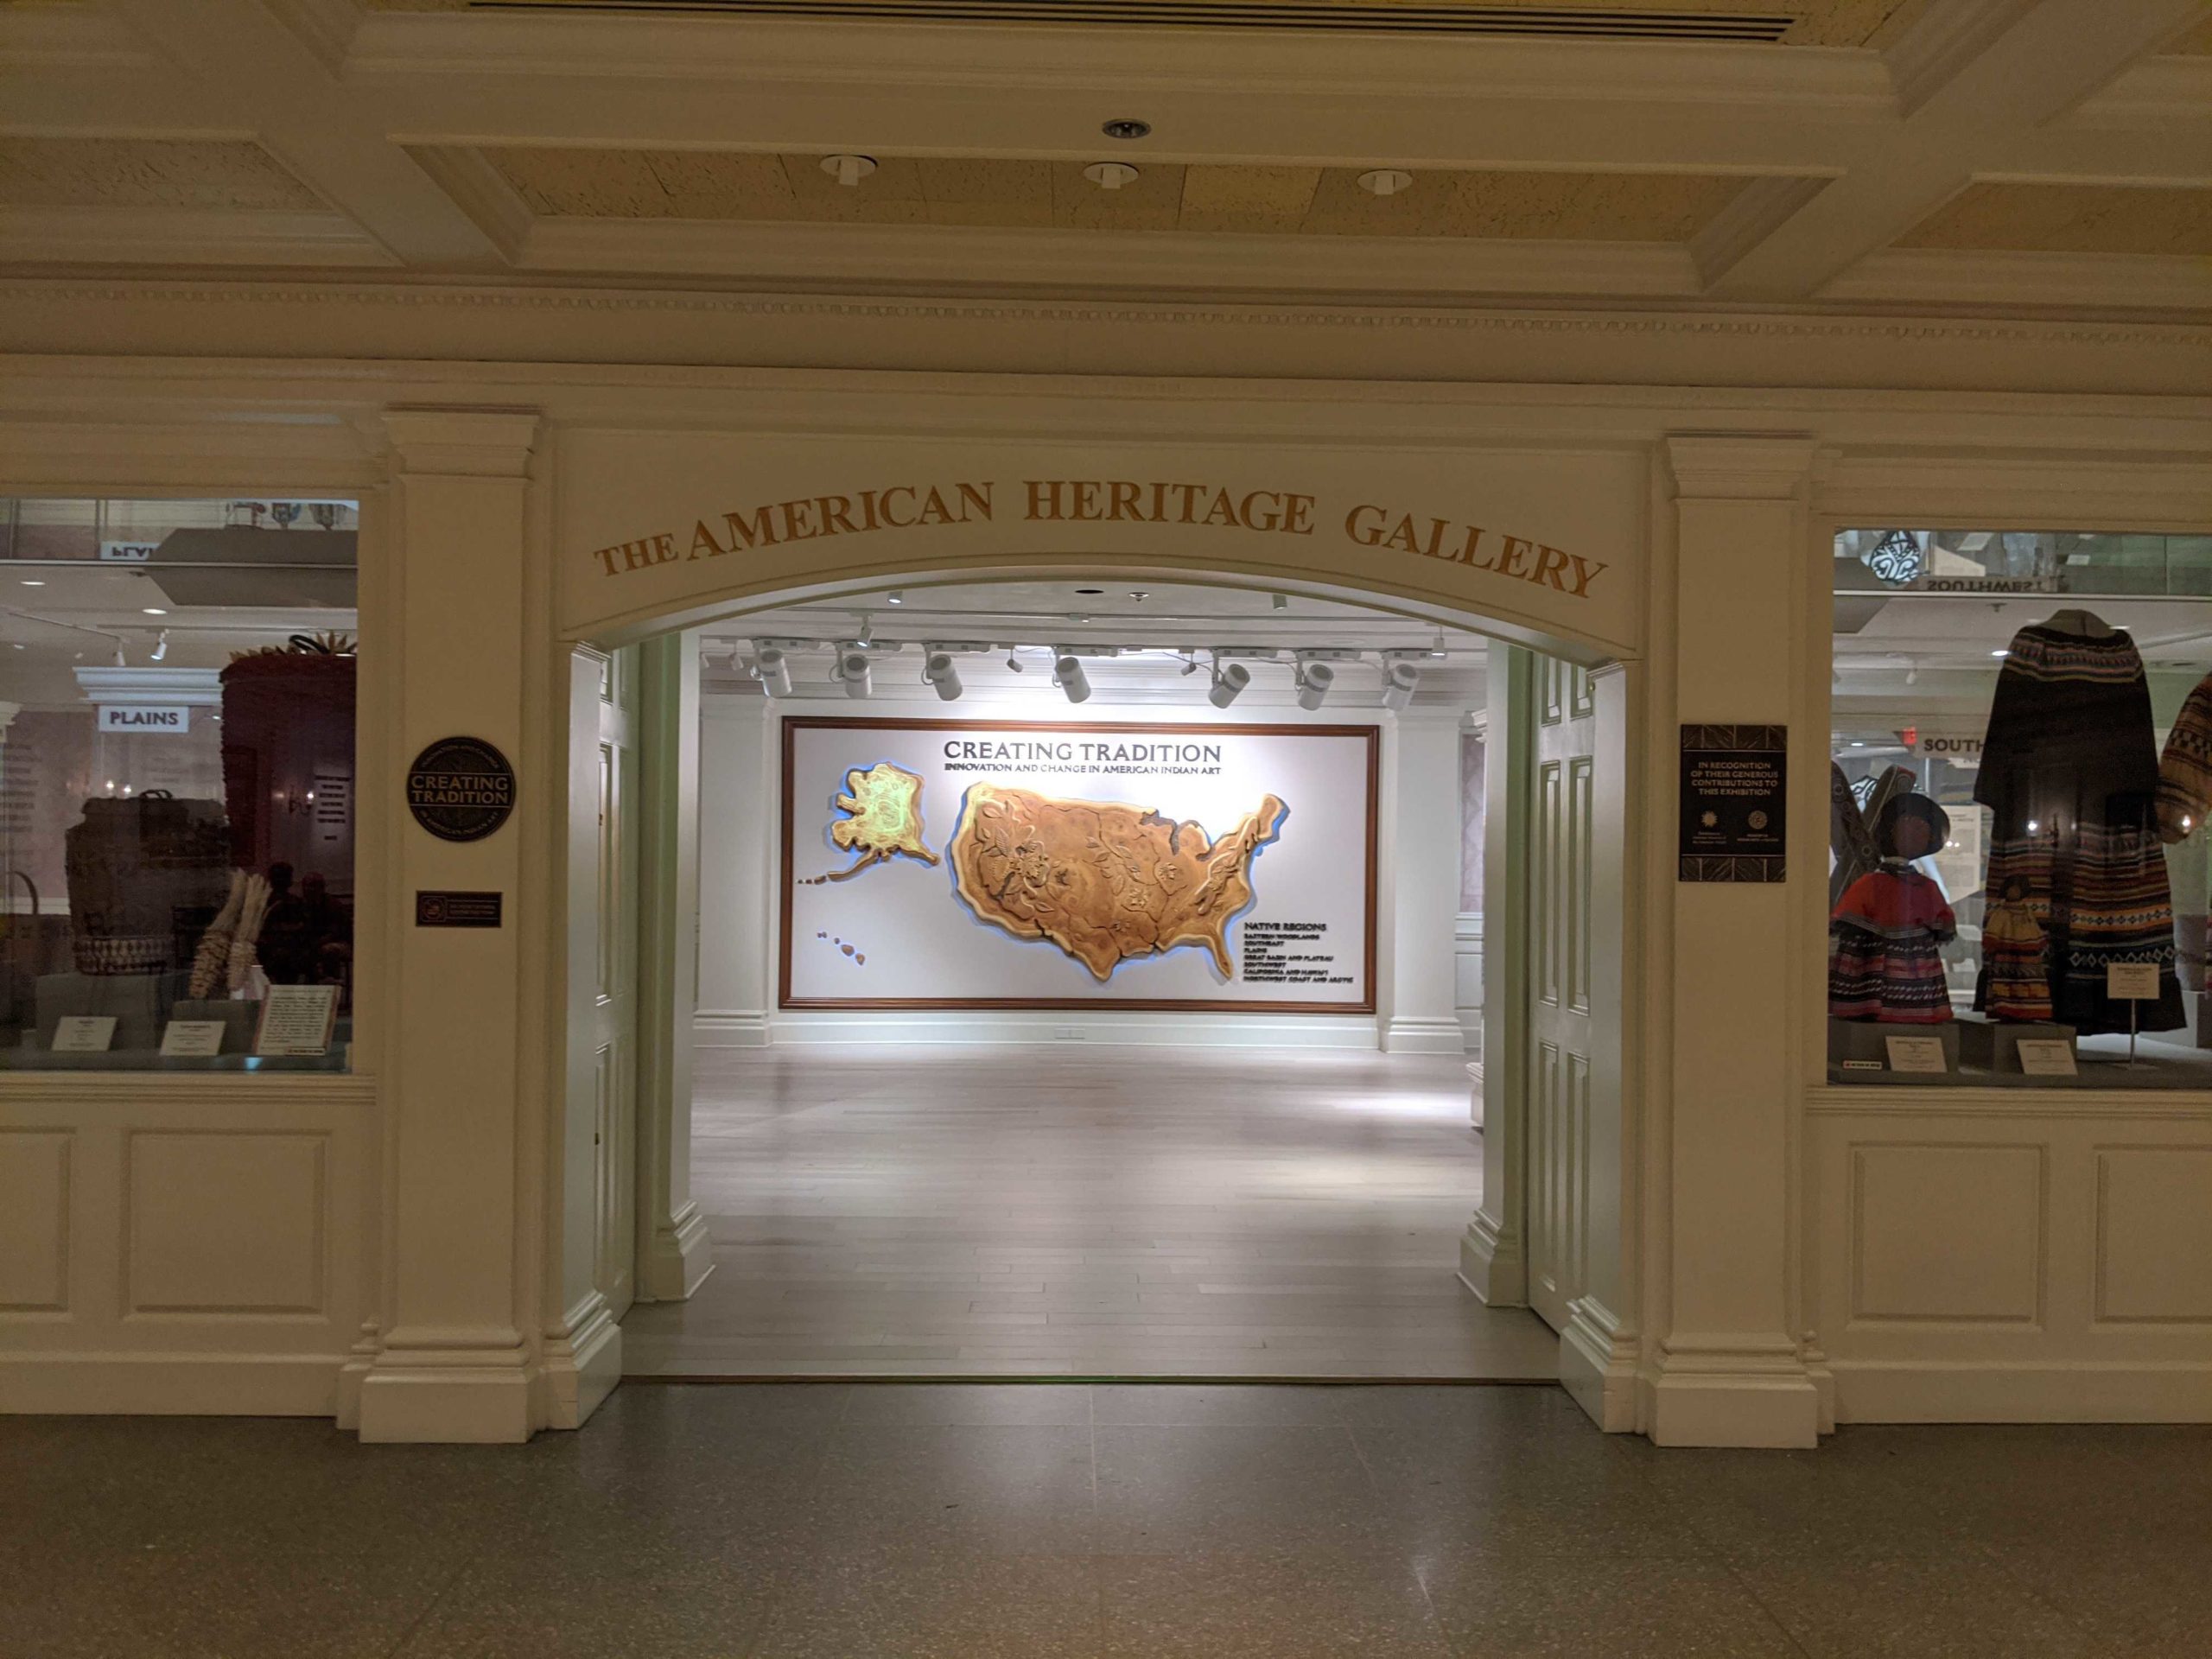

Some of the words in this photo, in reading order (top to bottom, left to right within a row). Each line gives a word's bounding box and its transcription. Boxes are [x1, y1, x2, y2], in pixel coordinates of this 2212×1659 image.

[594, 532, 679, 577] THE
[686, 481, 995, 561] AMERICAN
[1023, 480, 1316, 535] HERITAGE
[1344, 505, 1609, 599] GALLERY
[110, 711, 180, 726] PLAINS
[944, 741, 1072, 760] CREATING
[1078, 743, 1221, 762] TRADITION
[944, 762, 1012, 772] INNOVATION
[1014, 764, 1038, 772] AND
[1040, 764, 1086, 773] CHANGE
[1089, 765, 1100, 773] IN
[1103, 766, 1158, 774] AMERICAN
[1201, 766, 1221, 775] ART
[411, 774, 509, 791] CREATING
[411, 790, 508, 804] TRADITION
[1244, 922, 1281, 931] NATIVE
[1283, 923, 1327, 931] REGIONS
